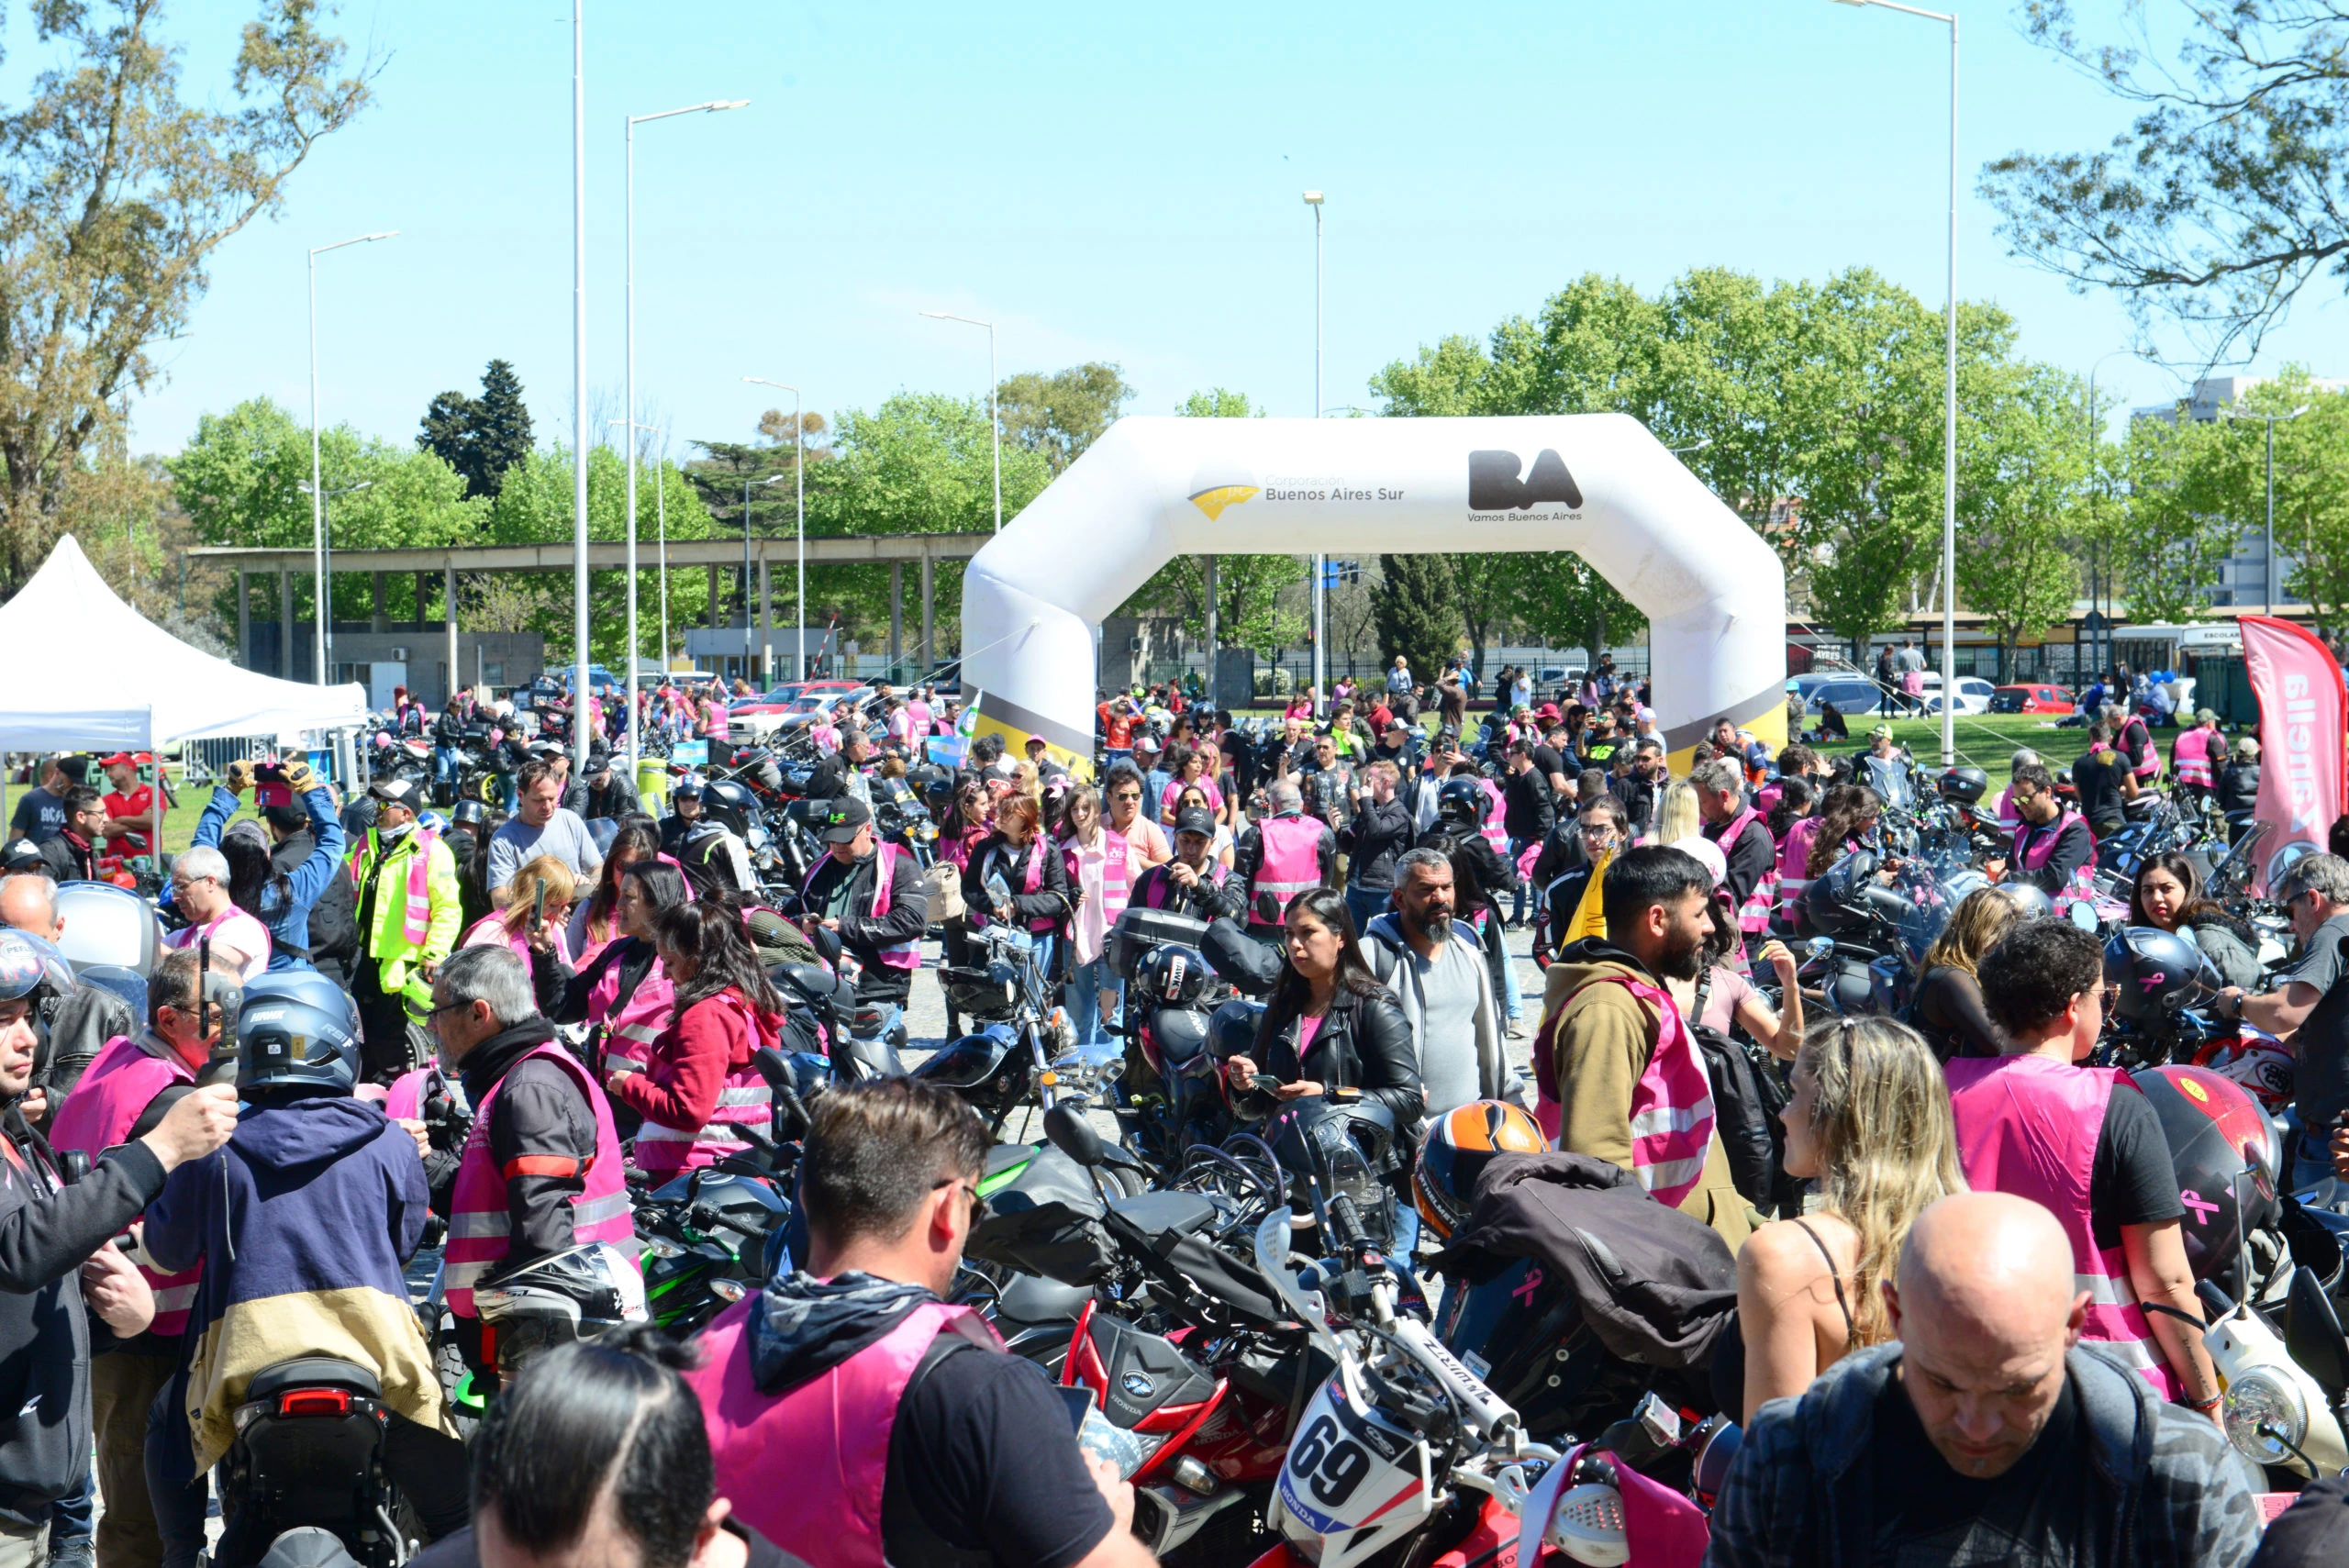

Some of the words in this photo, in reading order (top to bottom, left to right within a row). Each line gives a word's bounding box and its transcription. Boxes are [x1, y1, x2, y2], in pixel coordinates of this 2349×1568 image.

[1468, 449, 1583, 511] BA
[1265, 488, 1326, 501] Buenos
[1331, 488, 1373, 501] Aires
[1378, 488, 1405, 501] Sur
[1468, 514, 1505, 523] Vamos
[1508, 513, 1548, 522] Buenos
[1552, 512, 1582, 521] Aires
[250, 1010, 287, 1023] HAWK
[1110, 1394, 1144, 1417] HONDA
[1195, 1429, 1240, 1447] HONDA
[1290, 1414, 1371, 1507] 69
[1282, 1485, 1317, 1529] HONDA
